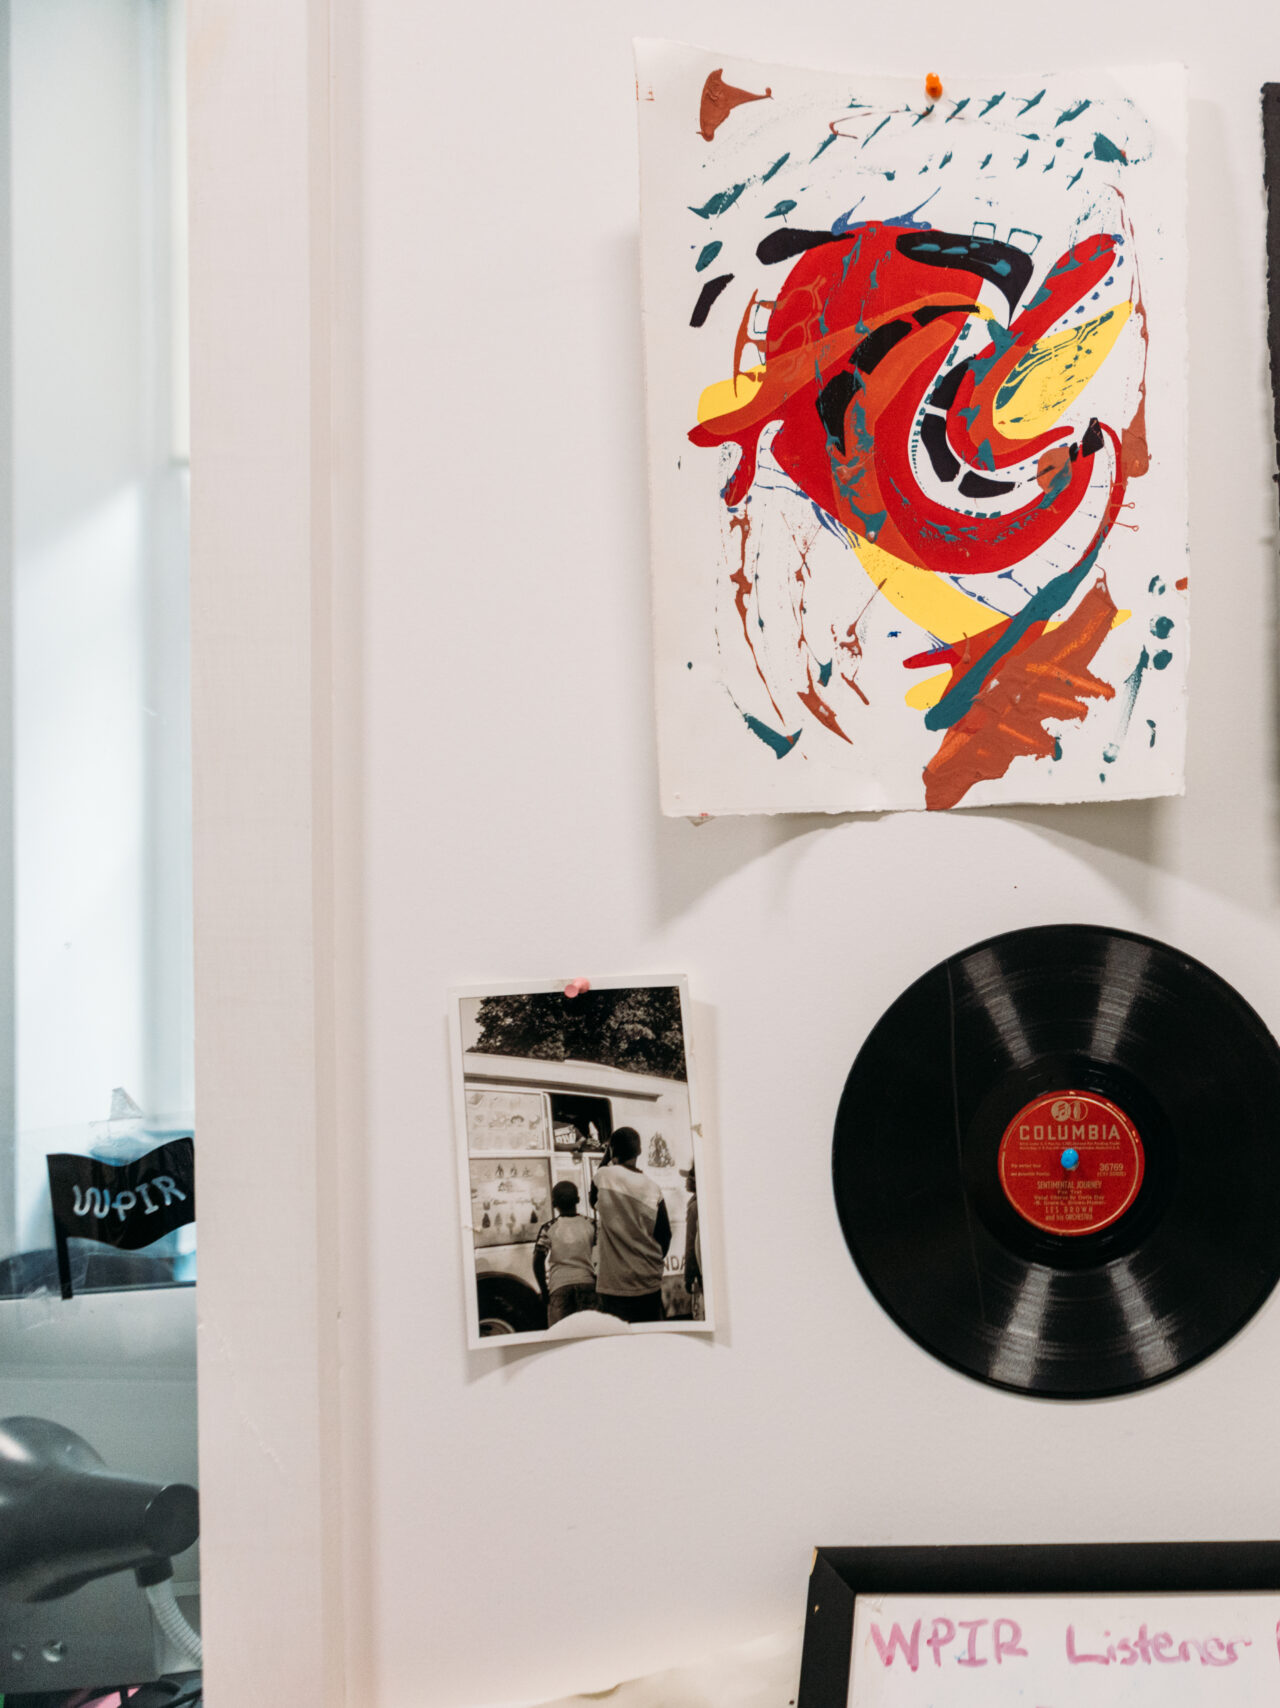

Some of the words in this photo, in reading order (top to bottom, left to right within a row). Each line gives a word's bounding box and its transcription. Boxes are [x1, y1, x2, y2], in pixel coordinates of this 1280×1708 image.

[1019, 1125, 1121, 1140] COLUMBIA
[1099, 1162, 1124, 1172] 36769
[1037, 1180, 1075, 1190] SENTIMENTAL
[1076, 1180, 1103, 1190] JOURNEY
[72, 1174, 188, 1222] WPIR
[1045, 1206, 1060, 1214] LES
[1063, 1206, 1093, 1214] BROWN
[870, 1617, 1029, 1672] WPIR
[1066, 1623, 1252, 1666] Listener
